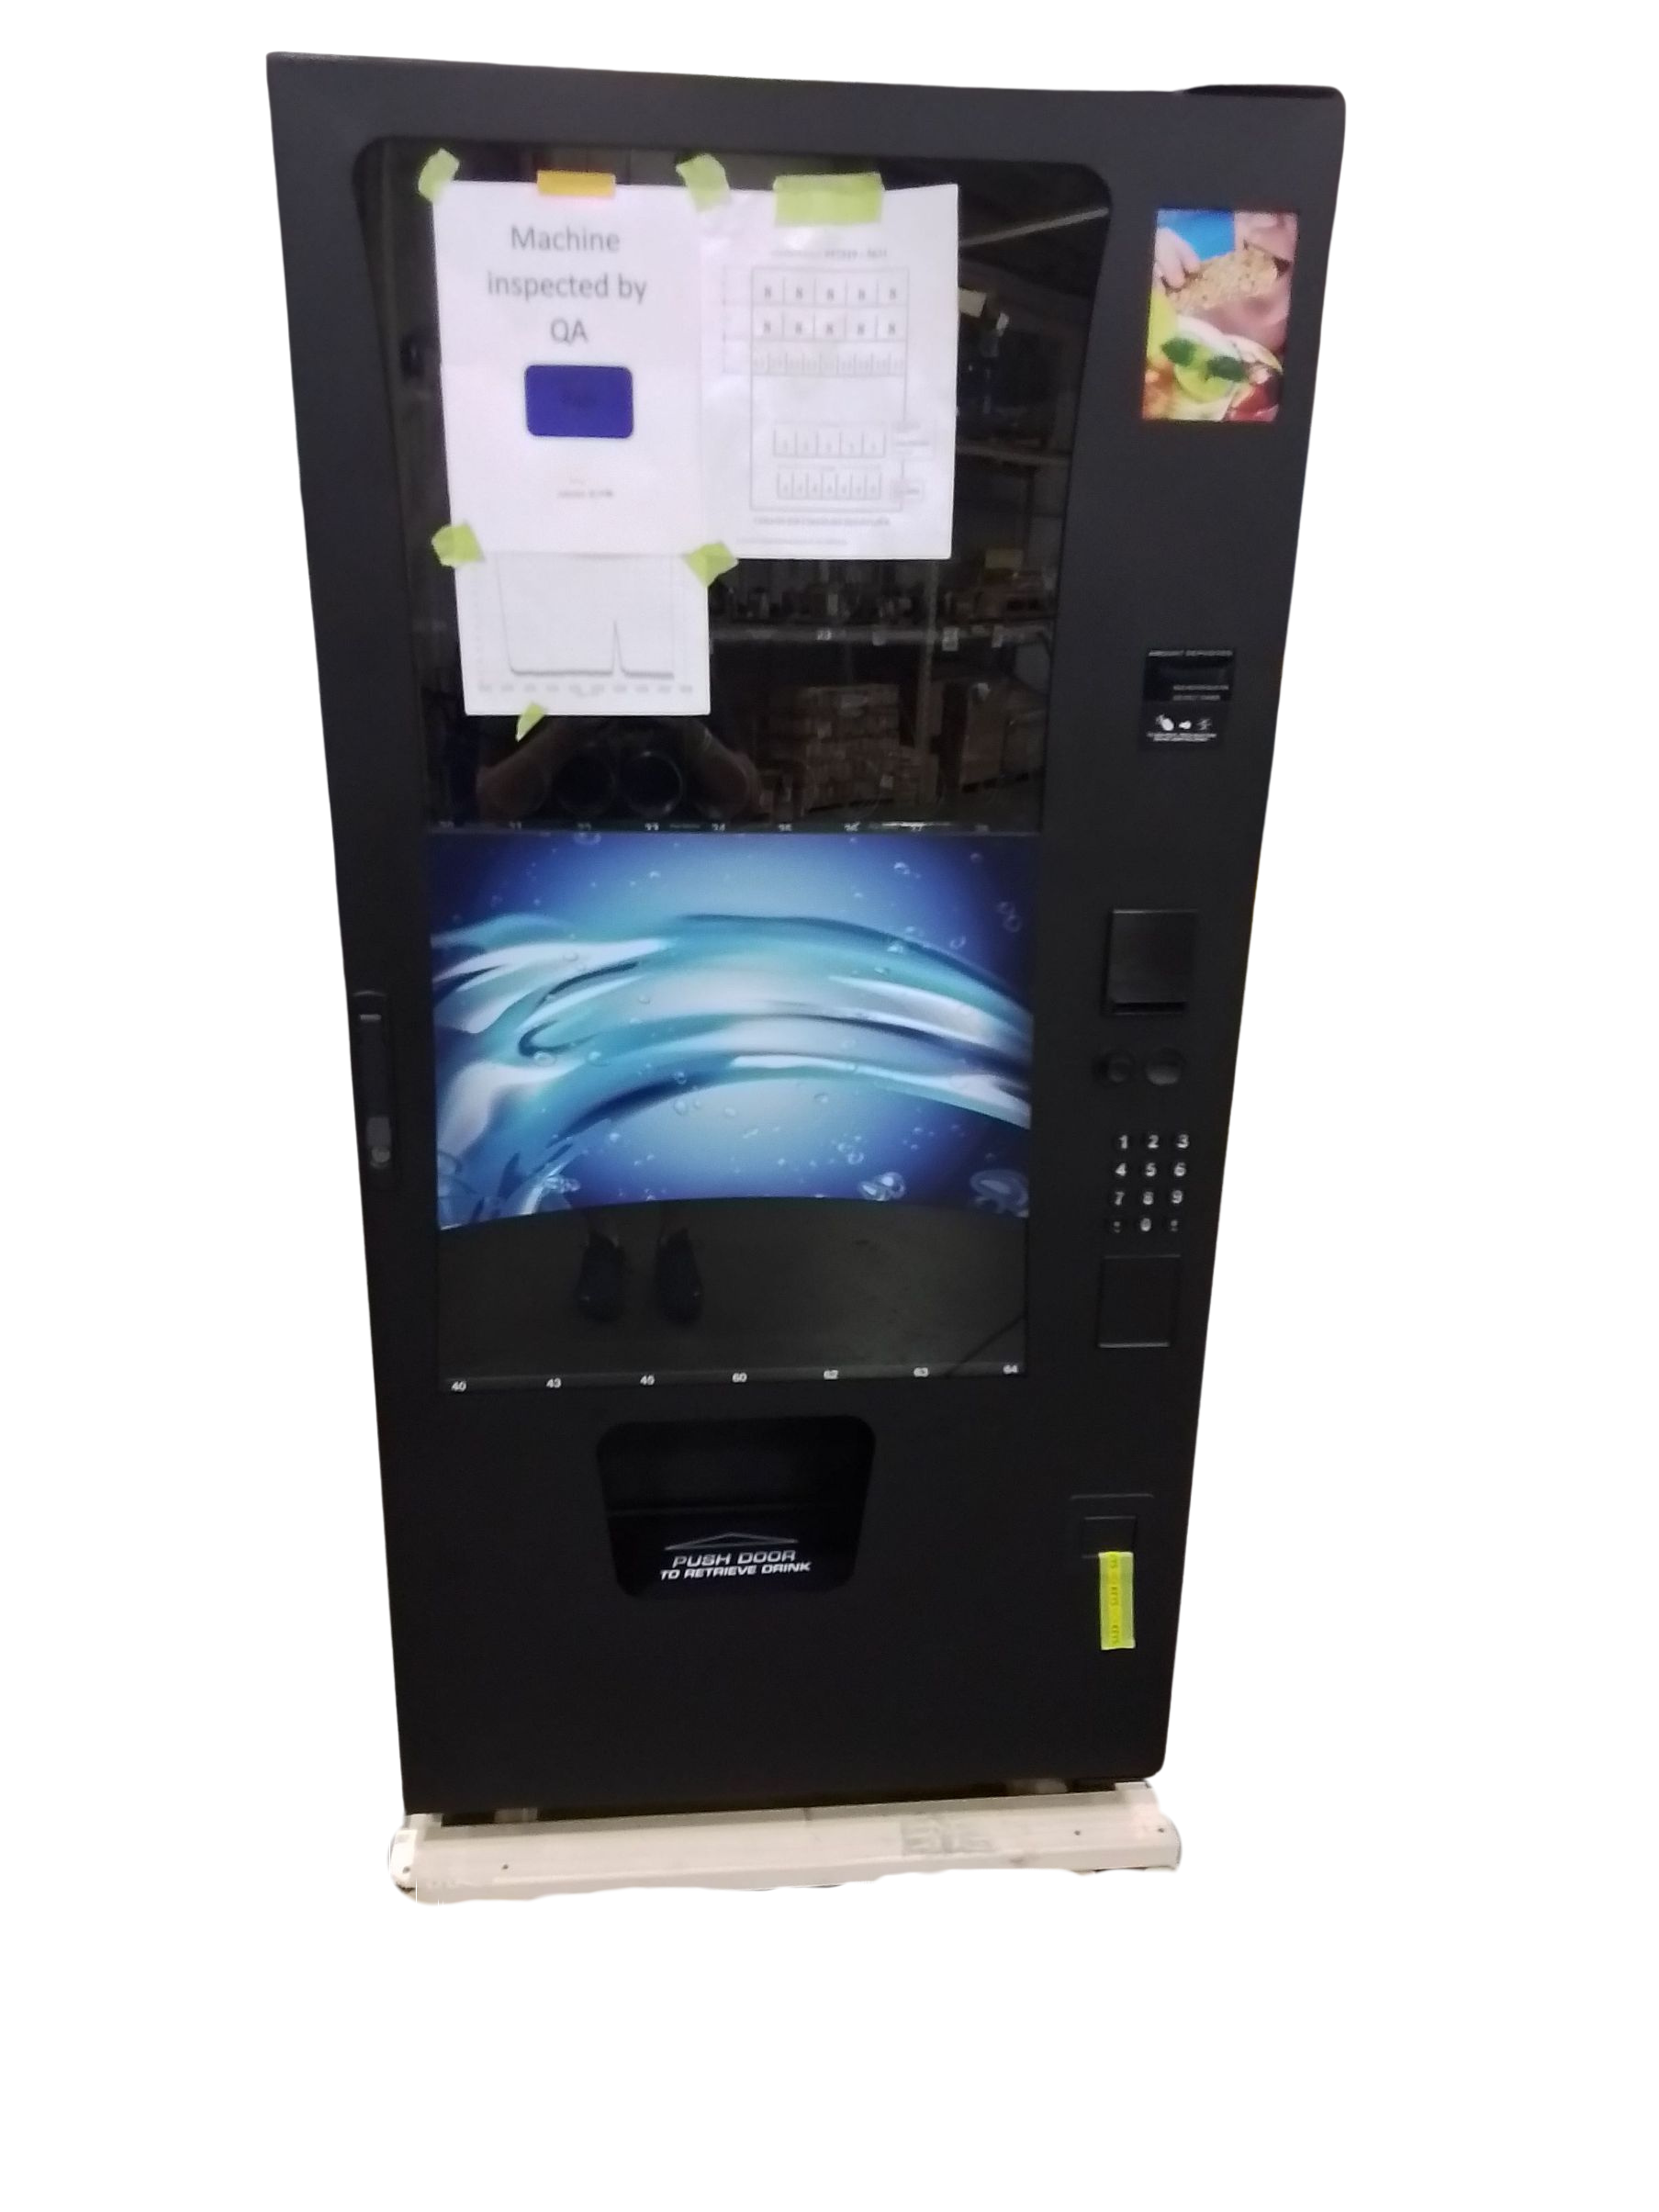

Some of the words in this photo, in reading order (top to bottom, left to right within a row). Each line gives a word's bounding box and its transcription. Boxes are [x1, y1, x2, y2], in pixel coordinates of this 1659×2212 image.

[510, 225, 621, 252] Machine
[488, 271, 609, 301] inspected
[618, 273, 647, 304] by
[551, 318, 588, 343] QA
[1118, 1134, 1128, 1150] 1
[1147, 1134, 1160, 1149] 2
[1176, 1134, 1190, 1149] 3
[1115, 1162, 1127, 1177] 4
[1145, 1162, 1157, 1177] 5
[1173, 1162, 1186, 1177] 6
[1114, 1191, 1125, 1206] 7
[1170, 1190, 1183, 1204] 9
[452, 1381, 466, 1391] 40
[672, 1553, 732, 1568] PUSH
[737, 1550, 796, 1564] DOOR
[660, 1569, 680, 1580] TO
[684, 1566, 757, 1579] RETRIEVE
[761, 1562, 812, 1574] DRINK
